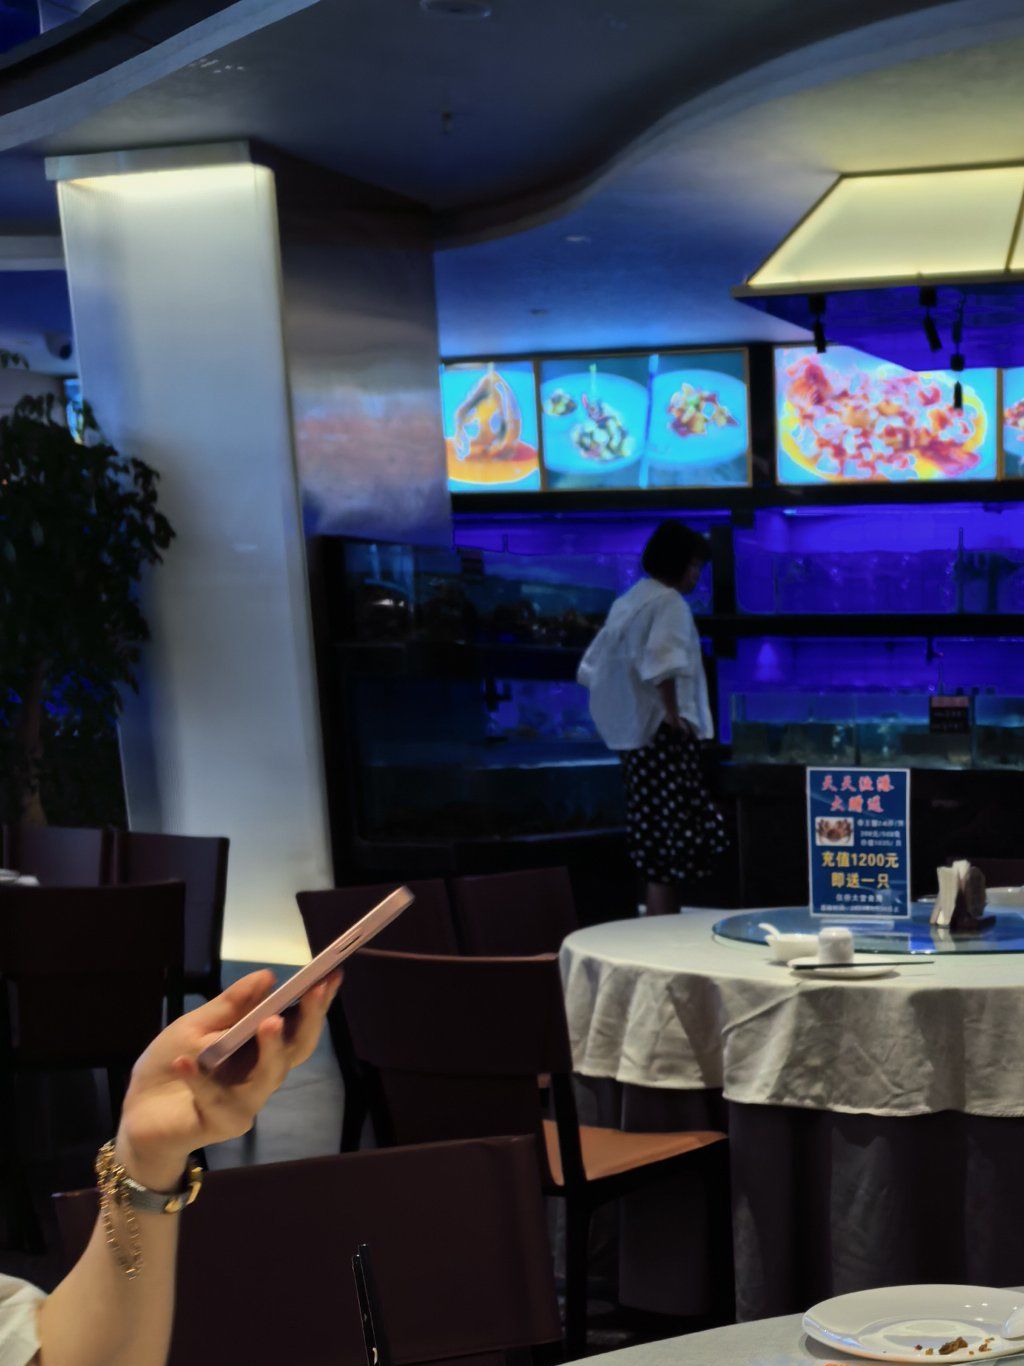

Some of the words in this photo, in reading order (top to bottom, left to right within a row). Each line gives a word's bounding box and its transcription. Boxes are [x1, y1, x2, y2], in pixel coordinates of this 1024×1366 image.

[821, 851, 900, 869] 充值1200元
[831, 872, 890, 889] 即送一只
